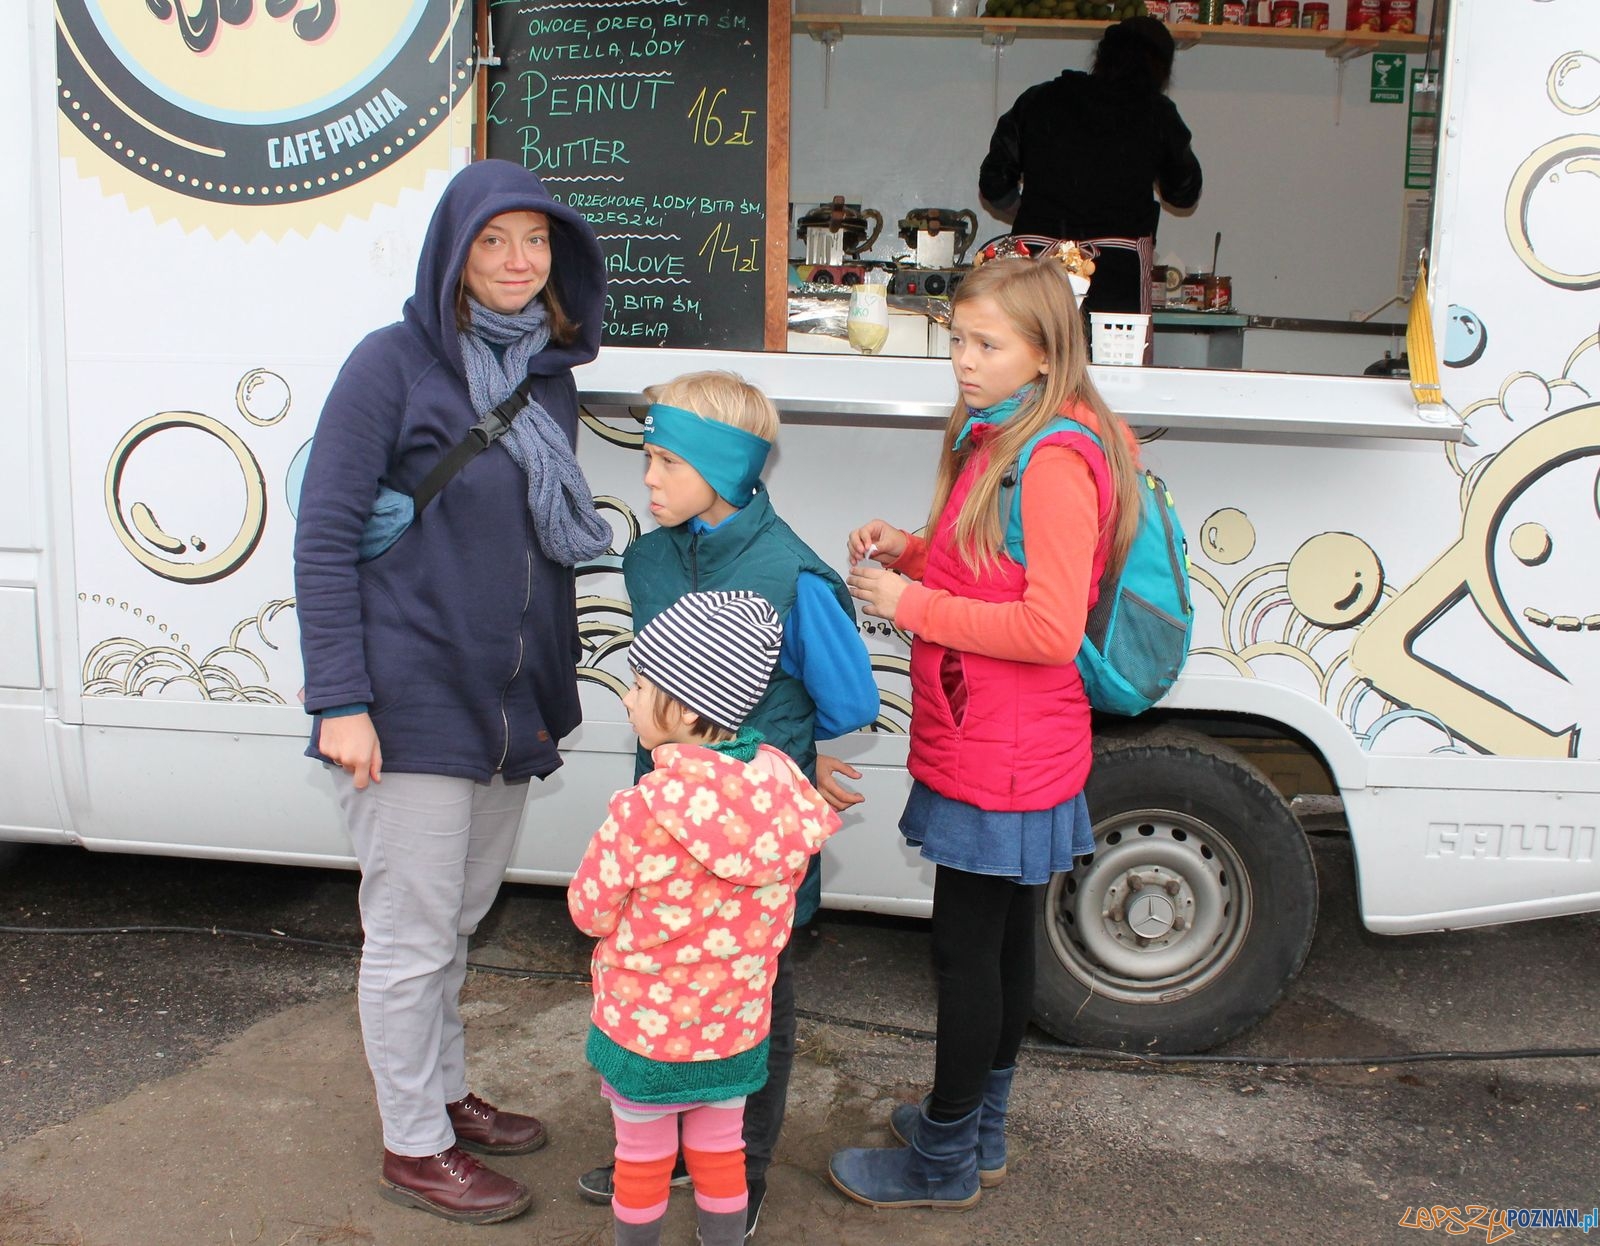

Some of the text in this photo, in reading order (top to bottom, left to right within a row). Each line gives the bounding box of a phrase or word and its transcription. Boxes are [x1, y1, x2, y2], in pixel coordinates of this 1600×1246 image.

[664, 14, 708, 28] BITA
[630, 39, 685, 56] LODY
[487, 81, 513, 125] 2.
[517, 71, 675, 118] PEANUT
[688, 87, 727, 146] 16
[267, 87, 408, 169] CAFE PRAHA
[516, 125, 630, 172] BUTTER
[699, 198, 735, 213] BITA
[605, 238, 685, 275] ALOVE
[623, 294, 664, 310] BITA
